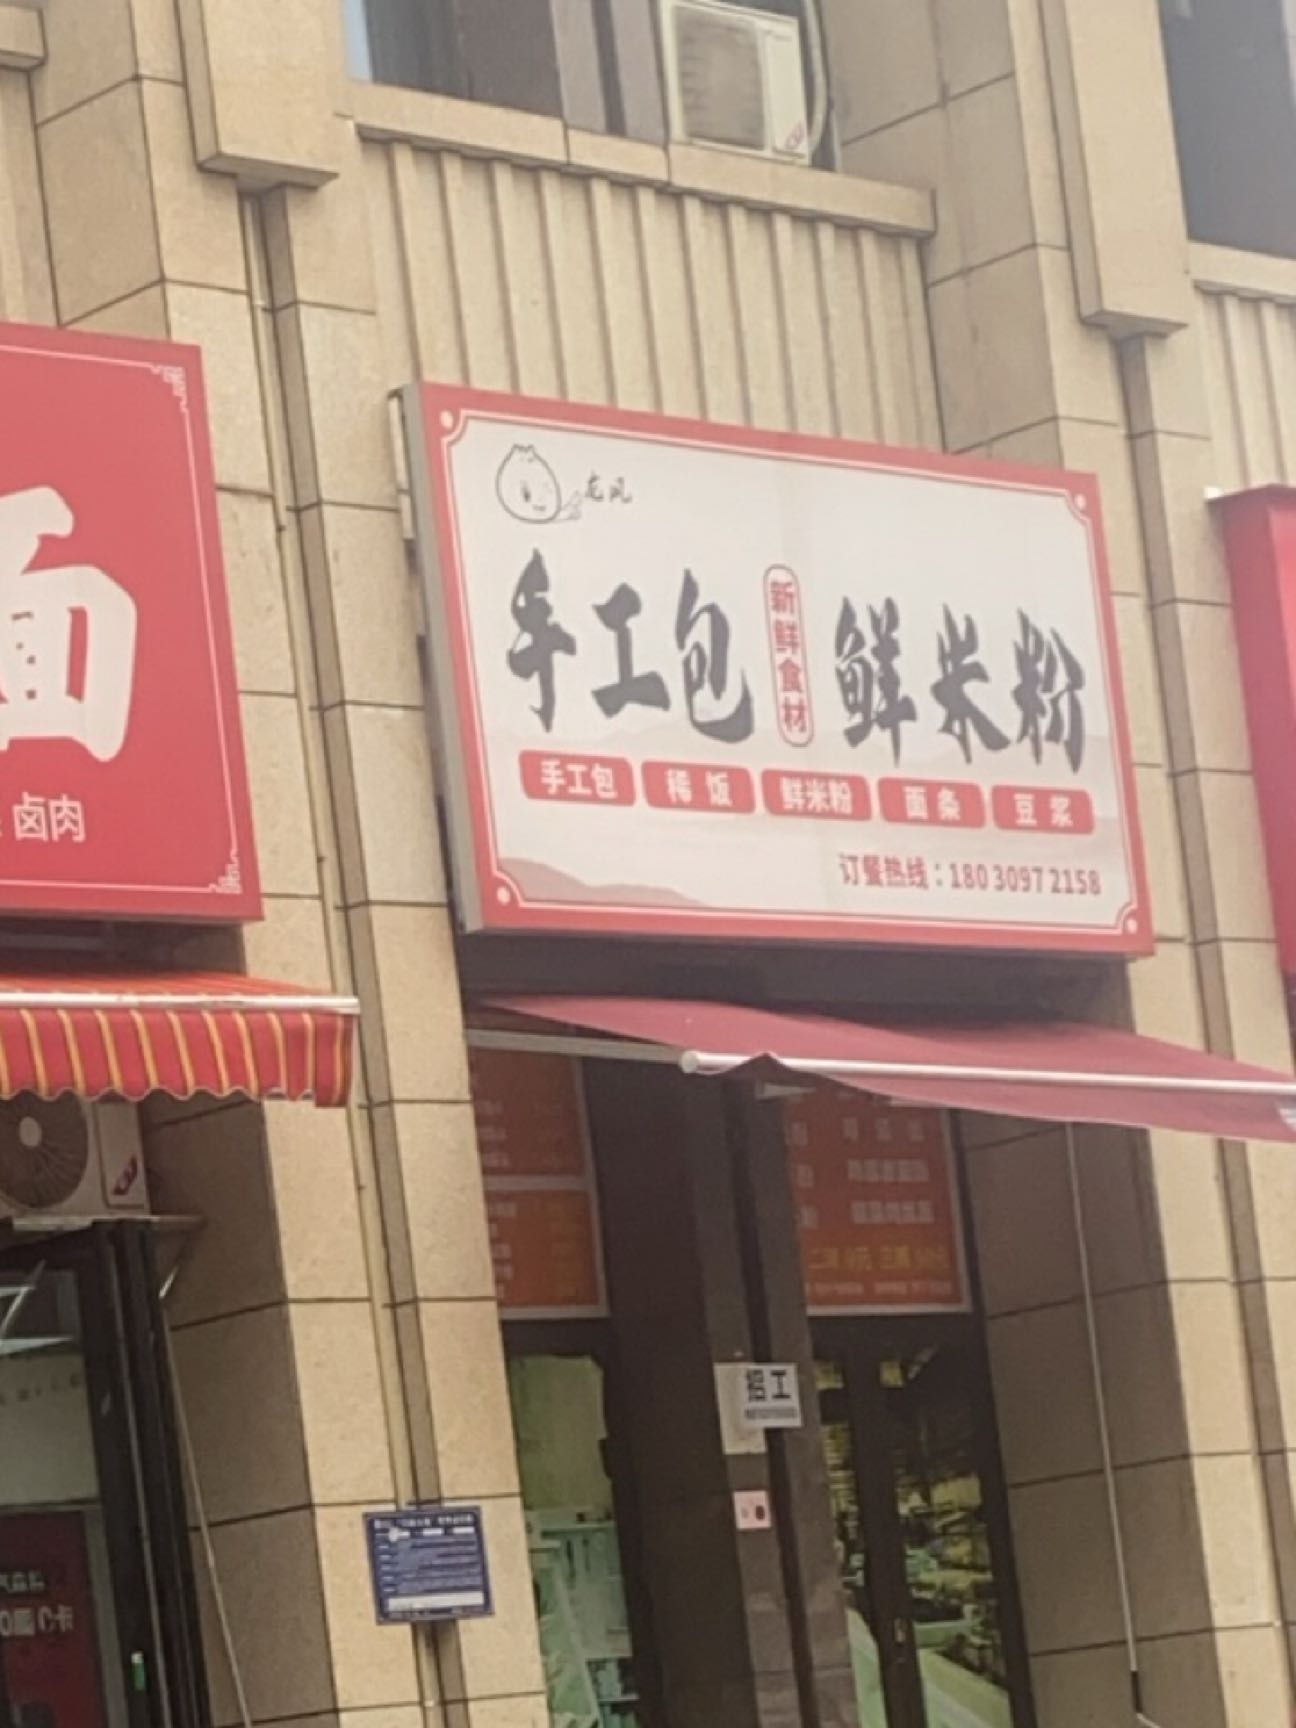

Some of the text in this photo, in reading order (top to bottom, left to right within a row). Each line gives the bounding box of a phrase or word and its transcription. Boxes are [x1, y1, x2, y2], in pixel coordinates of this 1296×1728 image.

[507, 548, 754, 743] 手工包
[769, 579, 808, 735] 新鲜食材
[834, 596, 1084, 774] 鲜米粉
[540, 762, 618, 800] 手工包
[780, 777, 854, 816] 鲜米粉
[903, 784, 962, 823] 面条
[12, 792, 86, 843] 卤肉
[1014, 792, 1074, 829] 豆浆
